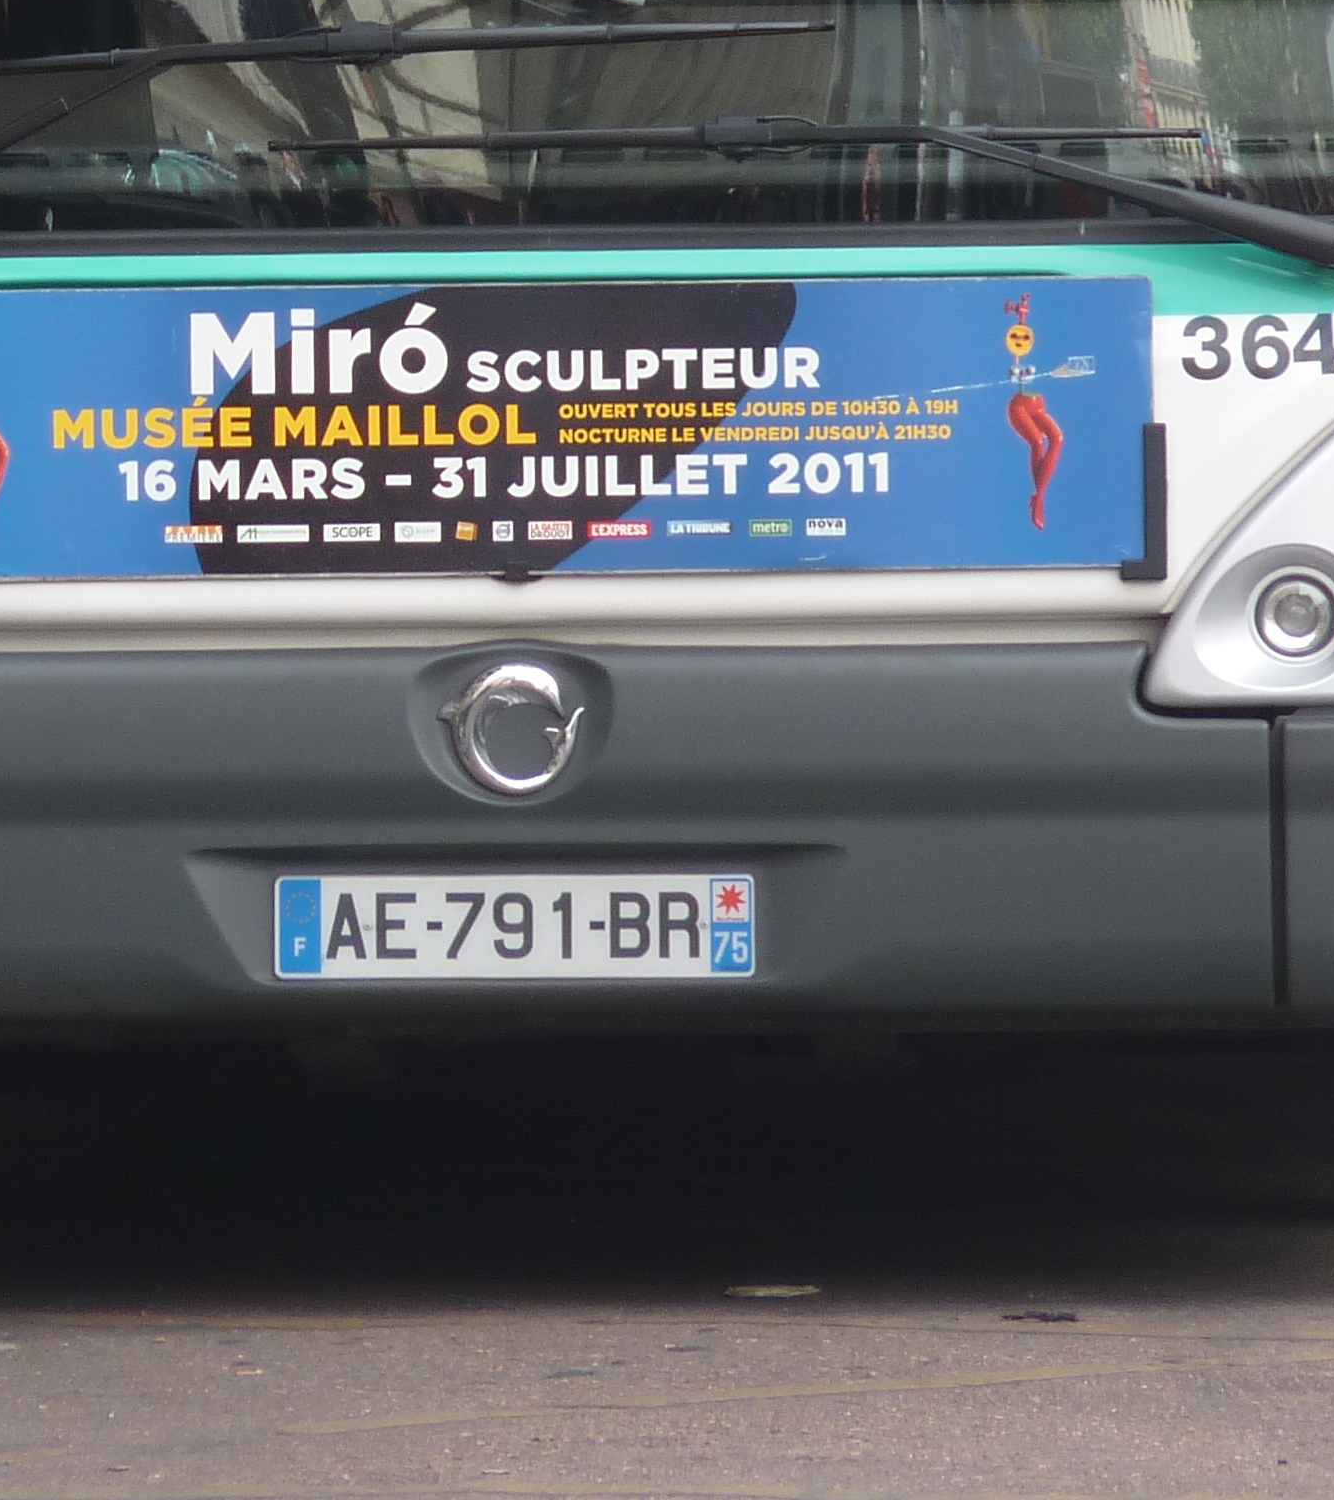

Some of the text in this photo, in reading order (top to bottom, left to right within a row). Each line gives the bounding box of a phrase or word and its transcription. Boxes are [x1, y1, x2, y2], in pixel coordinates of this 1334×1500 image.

[190, 302, 822, 395] Miró SCULPTEUR
[559, 396, 958, 419] OUVERT TOUS LES JOURS DE 10H30 À 19H
[52, 396, 537, 450] MUSÉE MAILLOL
[559, 421, 952, 444] NOCTURNE LE VENDREDI JUSQU'À 21H30
[119, 459, 177, 502] 16
[198, 458, 366, 501] MARS
[432, 457, 487, 499] 31
[507, 455, 748, 498] JUILLET
[767, 452, 889, 497] 2011
[331, 526, 374, 539] SCOPE
[592, 523, 648, 537] L'EXPRESS
[671, 522, 730, 534] LA TRIBUNE
[752, 521, 789, 534] metro
[808, 518, 843, 529] nova
[326, 891, 701, 960] AE-791-BR
[293, 936, 306, 958] F
[713, 930, 750, 964] 75
